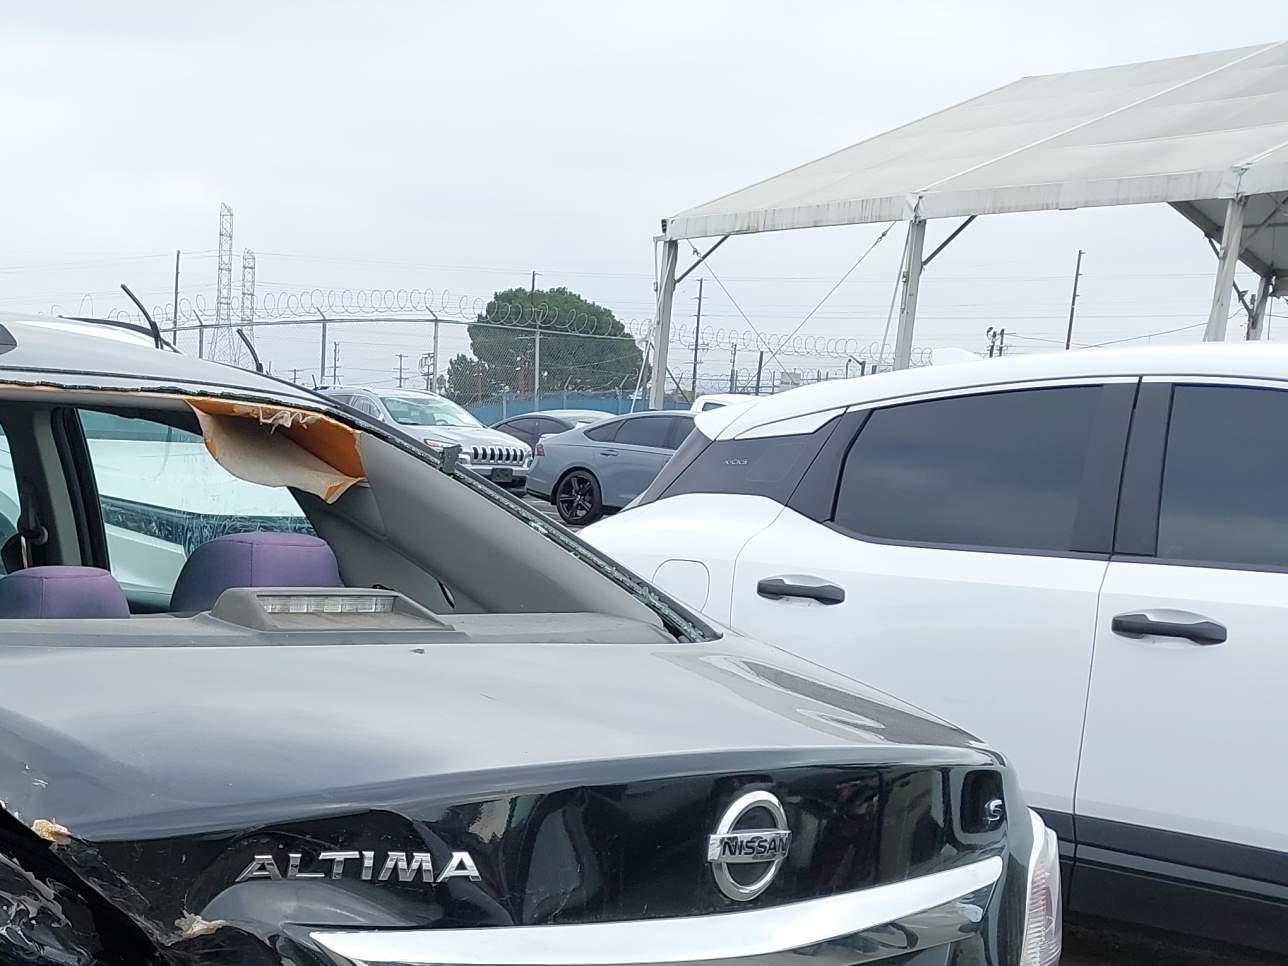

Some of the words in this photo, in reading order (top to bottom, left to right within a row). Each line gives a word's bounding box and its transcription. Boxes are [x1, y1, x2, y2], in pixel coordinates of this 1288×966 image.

[984, 799, 1002, 821] S
[721, 836, 788, 857] NISSAN
[235, 851, 482, 883] ALTIMA
